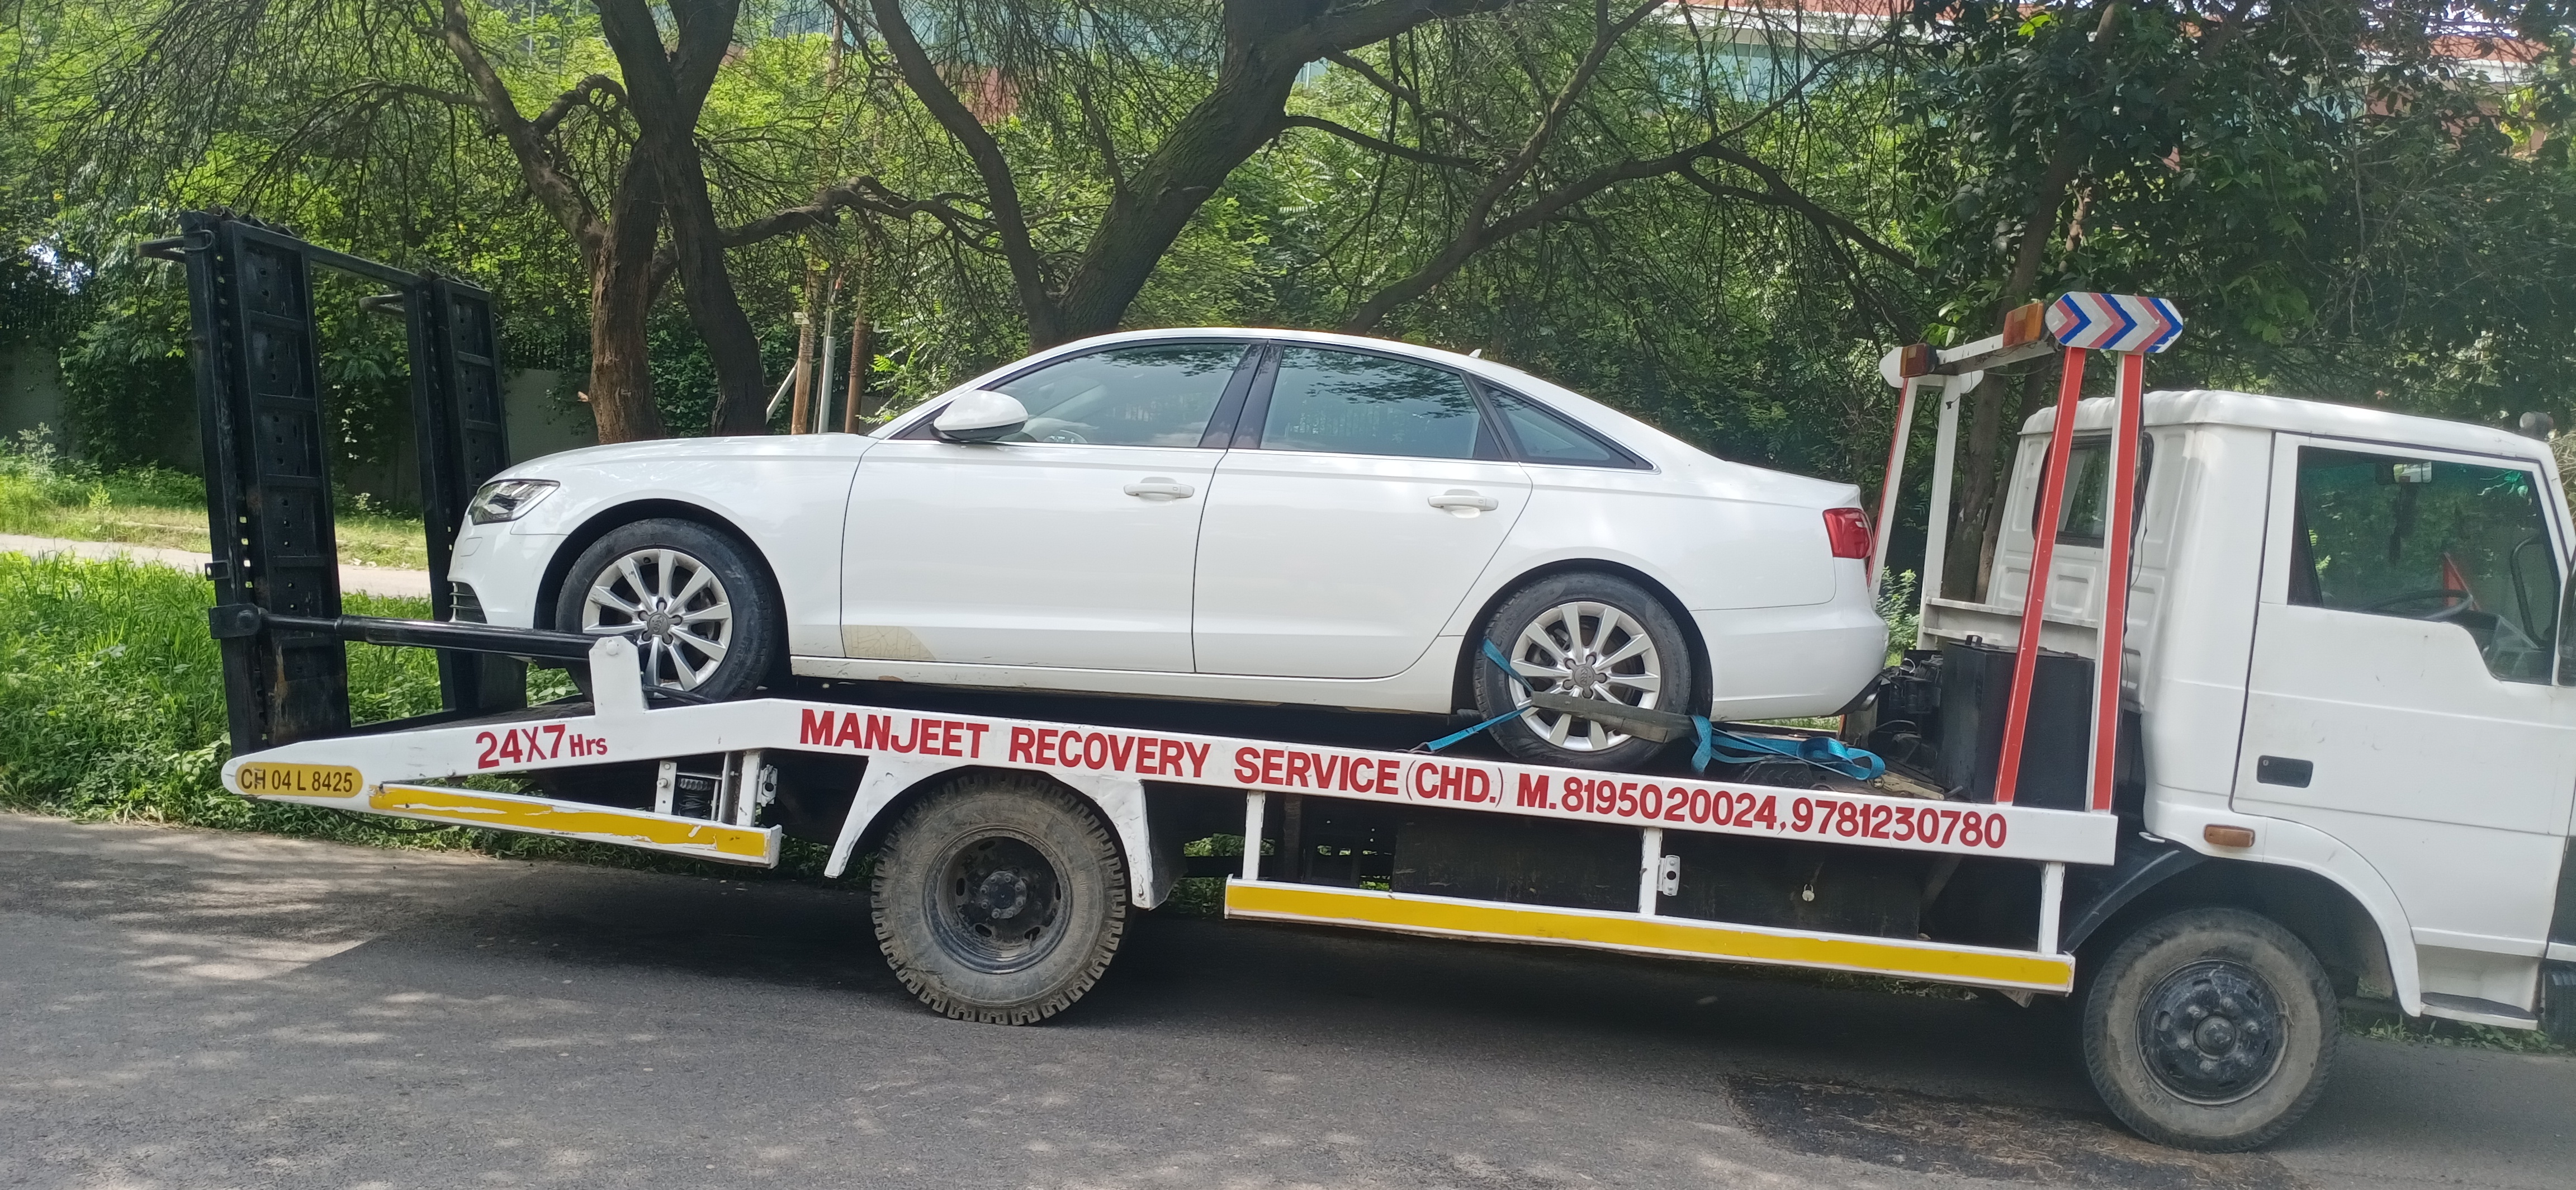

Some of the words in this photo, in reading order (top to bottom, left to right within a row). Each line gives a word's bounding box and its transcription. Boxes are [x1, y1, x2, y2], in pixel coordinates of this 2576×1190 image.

[476, 724, 566, 769] 24X7
[570, 734, 608, 757] Hrs
[800, 709, 989, 759] MANJEET
[1009, 726, 1211, 778] RECOVERY
[241, 768, 266, 790] CH
[272, 769, 291, 791] 04
[297, 770, 306, 791] L
[311, 771, 353, 792] 8425
